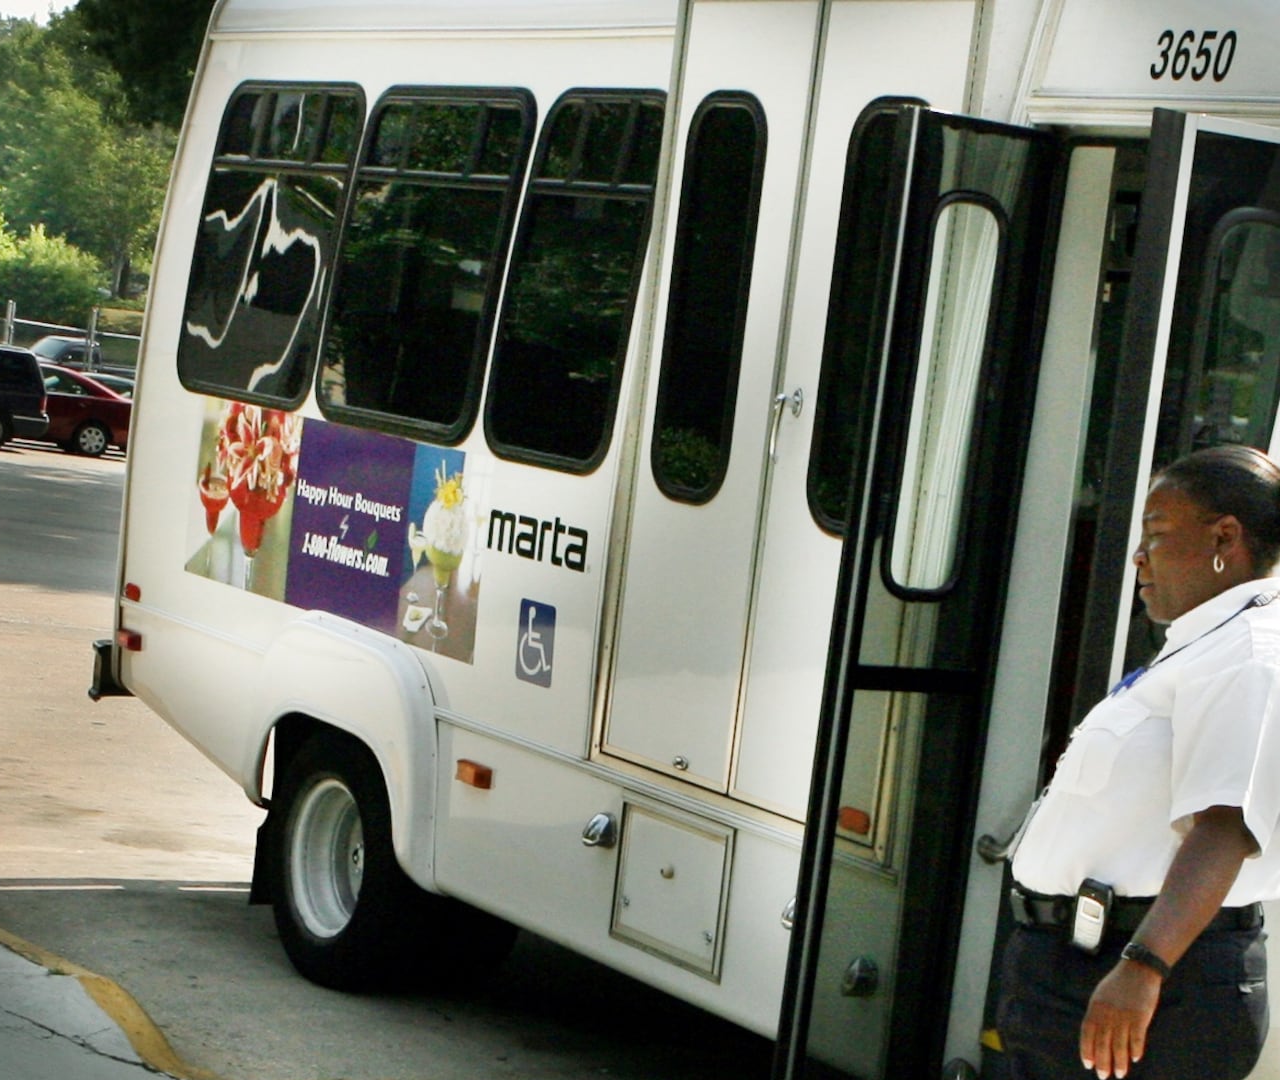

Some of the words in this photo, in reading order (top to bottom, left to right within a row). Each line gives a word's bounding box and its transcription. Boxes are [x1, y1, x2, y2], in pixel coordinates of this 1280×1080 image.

[1150, 29, 1237, 82] 3650
[297, 478, 328, 507] Happy
[328, 486, 354, 510] Hour
[354, 492, 402, 522] Bouquets
[487, 509, 588, 573] marta
